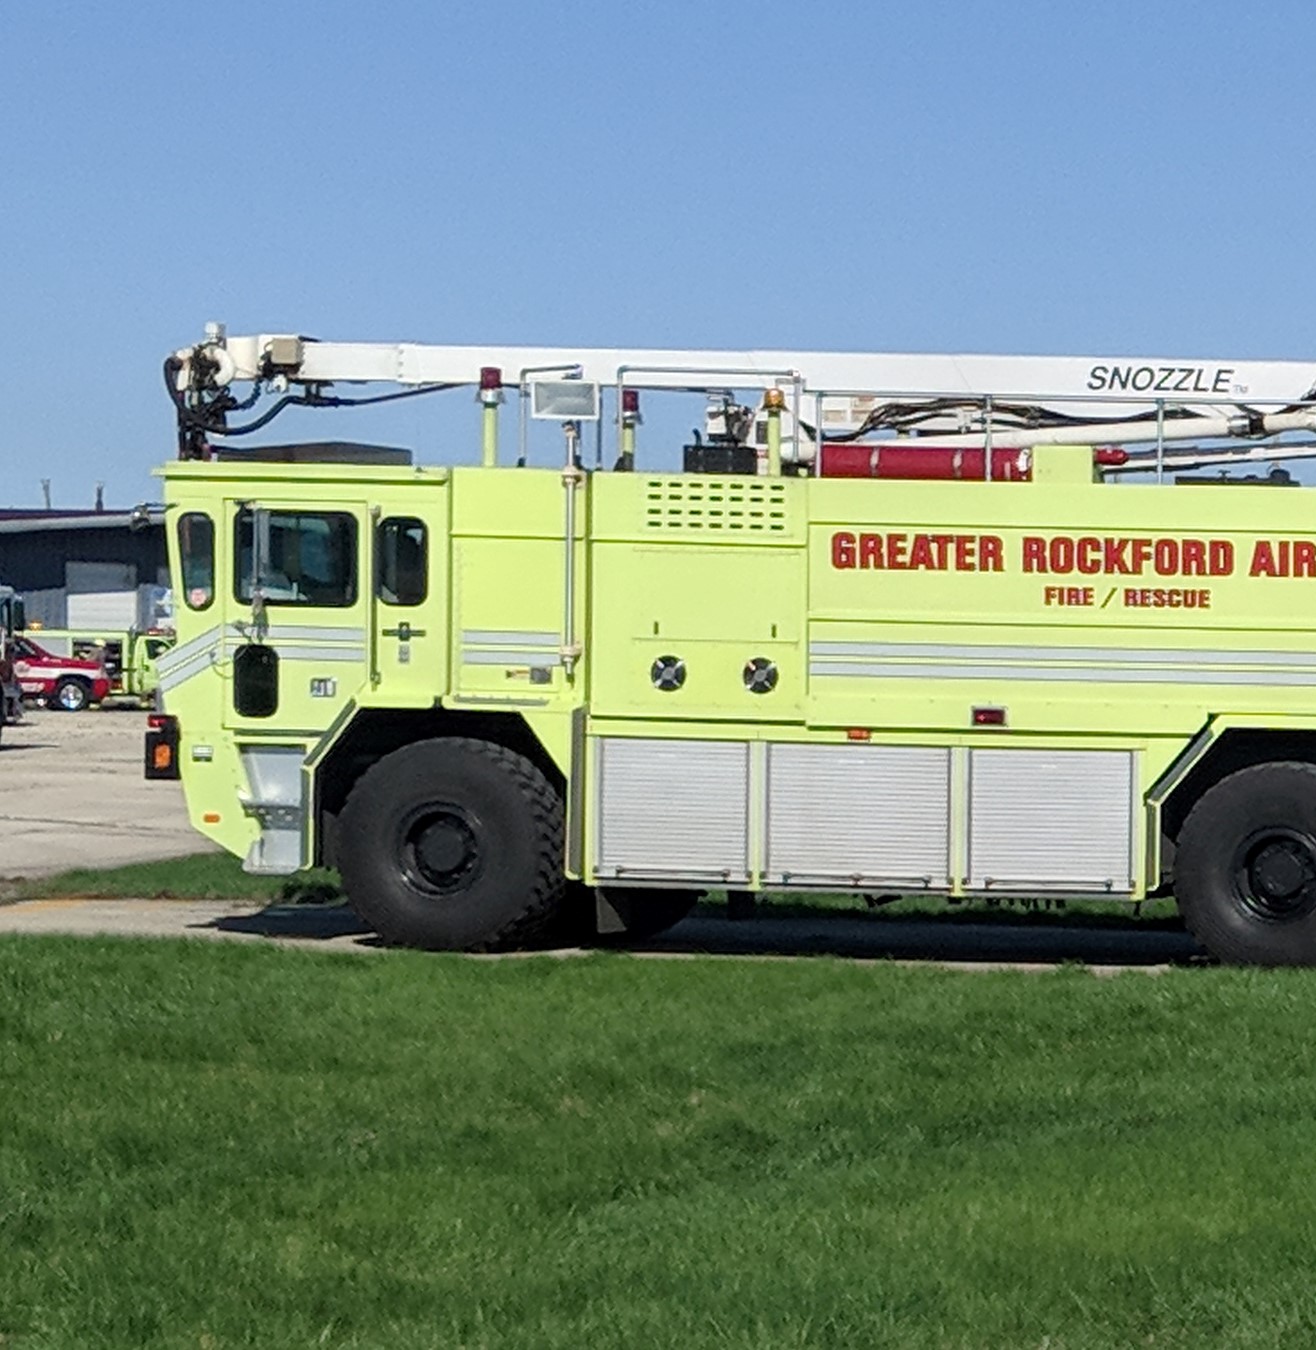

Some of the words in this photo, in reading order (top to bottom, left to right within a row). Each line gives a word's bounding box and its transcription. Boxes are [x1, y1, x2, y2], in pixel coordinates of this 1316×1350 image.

[1087, 366, 1235, 393] SNOZZLE
[831, 532, 1005, 573] GREATER
[1022, 537, 1234, 576] ROCKFORD
[1044, 587, 1094, 606] FIRE
[1124, 589, 1211, 609] RESCUE
